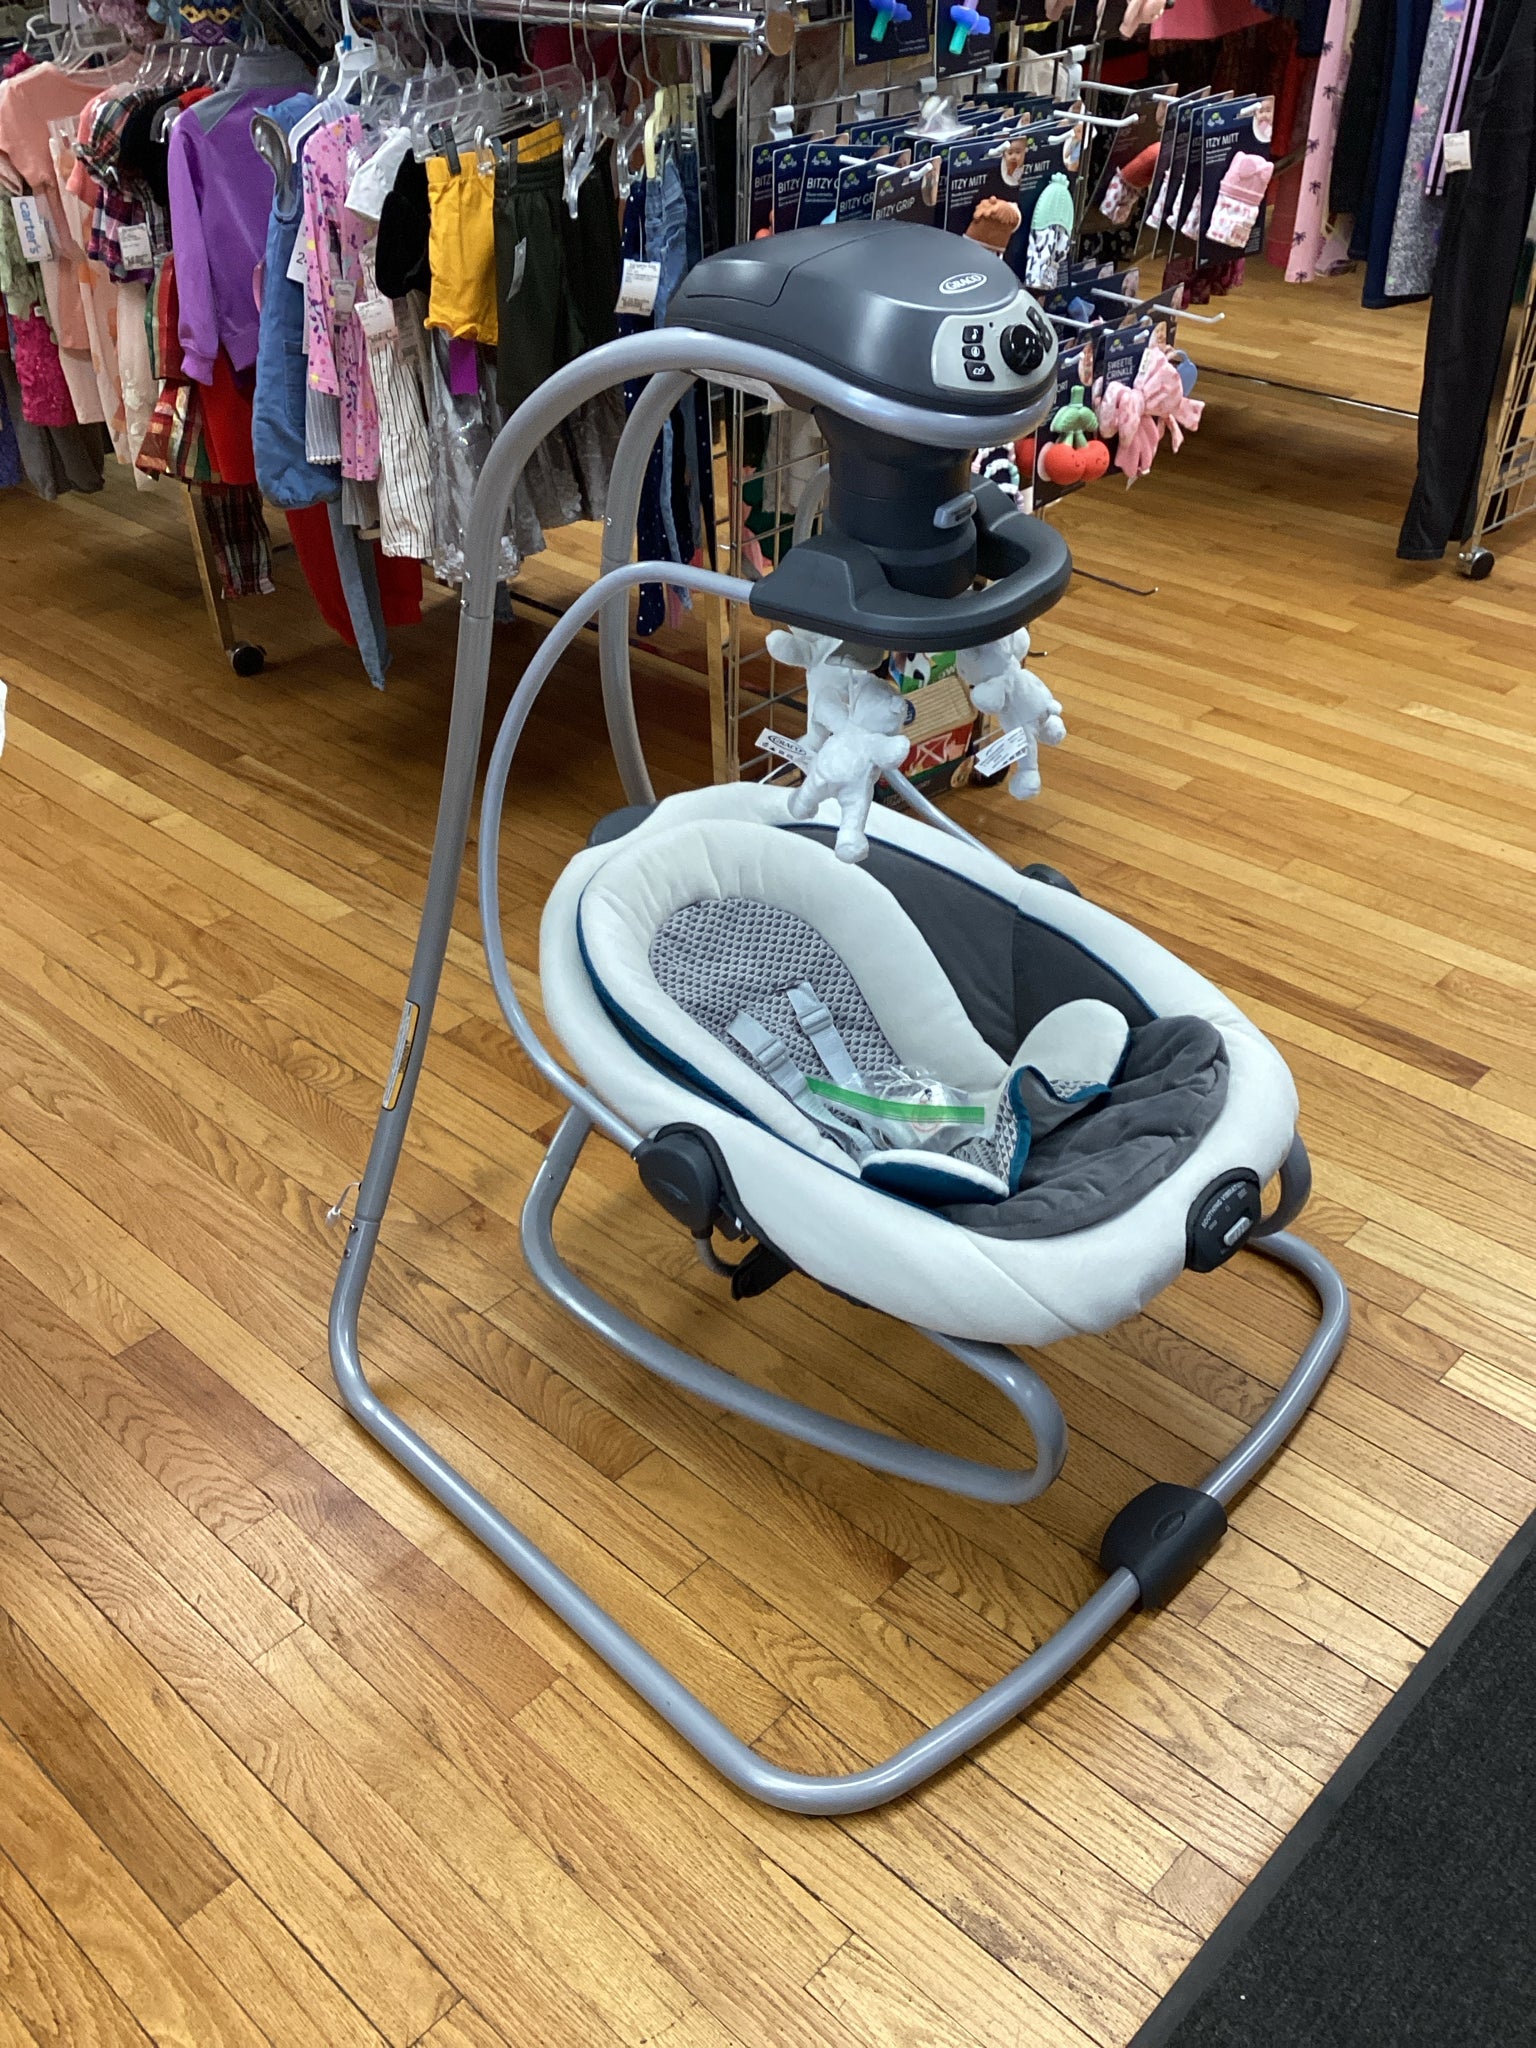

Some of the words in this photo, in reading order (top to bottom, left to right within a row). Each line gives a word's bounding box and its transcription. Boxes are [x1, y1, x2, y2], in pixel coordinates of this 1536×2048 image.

[1206, 135, 1221, 148] ITZY
[1222, 132, 1239, 146] MITT
[1034, 160, 1050, 172] MITT
[754, 173, 772, 188] BITZ
[807, 177, 834, 190] BITZY
[951, 177, 968, 191] ITZY
[968, 174, 988, 187] MITT
[840, 195, 862, 213] BITZY
[876, 204, 895, 221] BITZY
[896, 196, 916, 212] GRIP
[19, 201, 40, 255] carter's
[943, 274, 983, 291] GRACO
[1107, 355, 1134, 371] SWEETIE
[1106, 366, 1133, 380] CRINKLE
